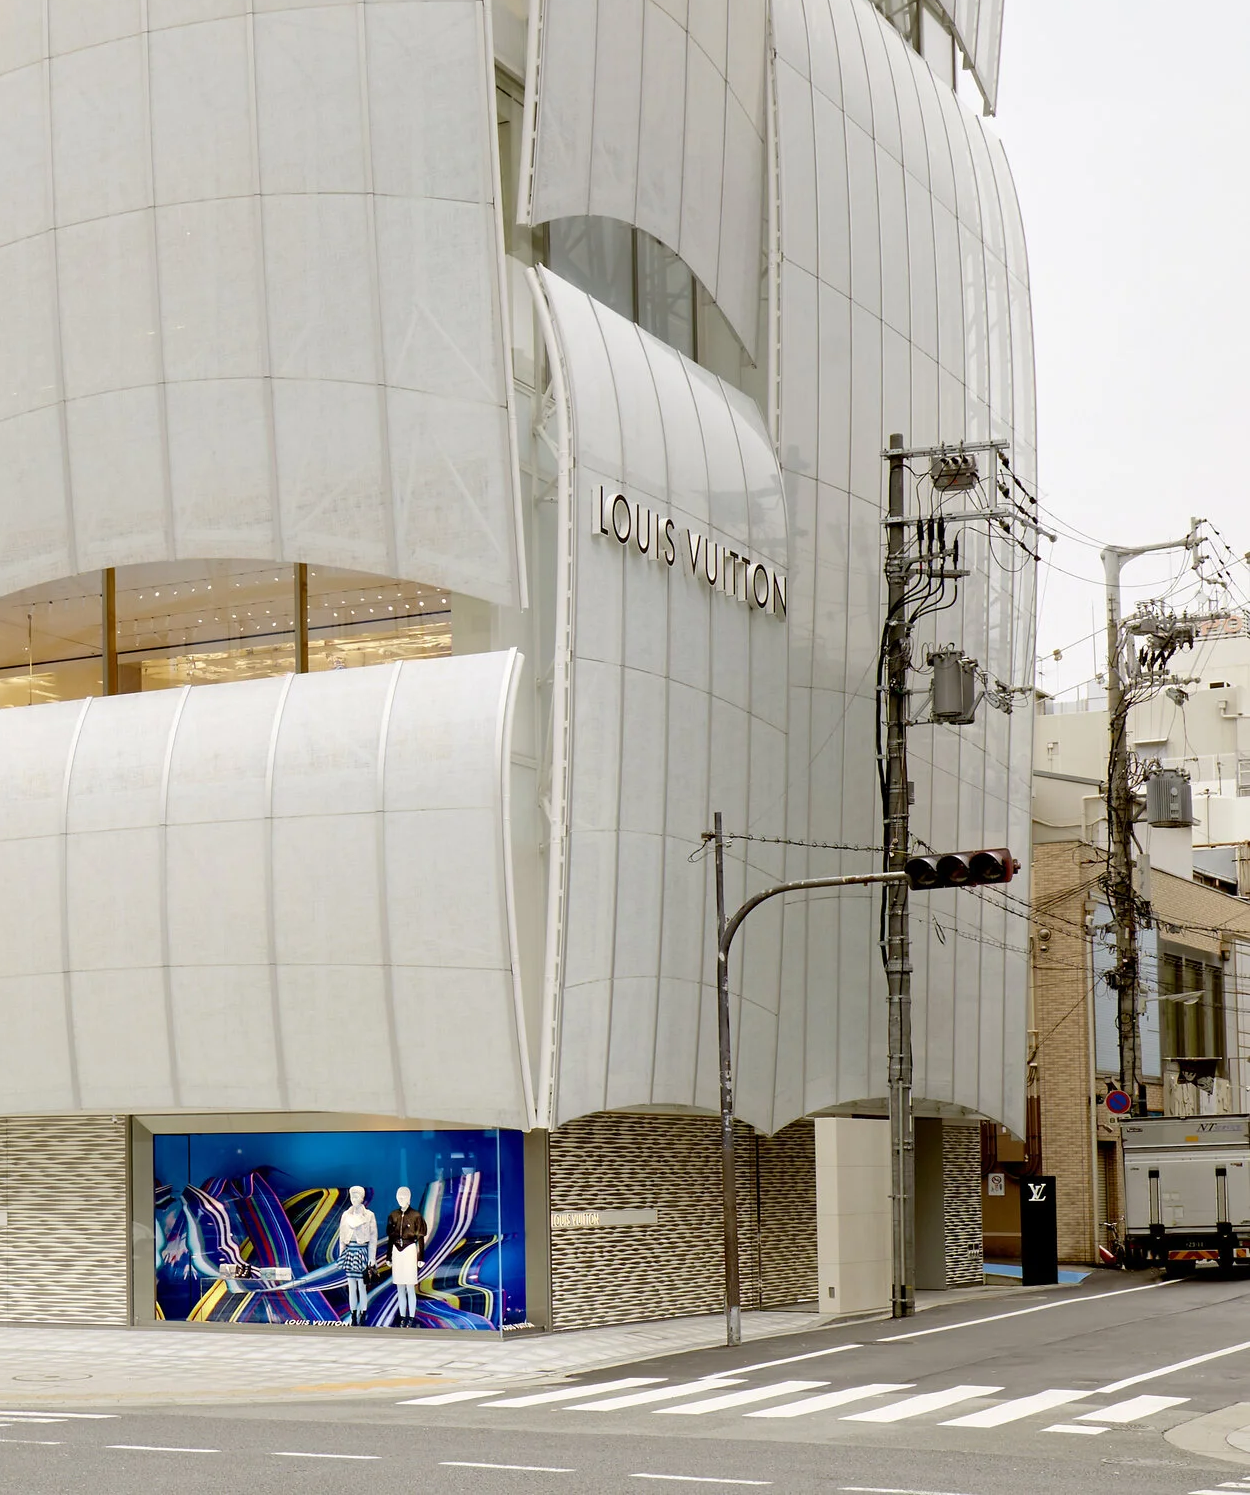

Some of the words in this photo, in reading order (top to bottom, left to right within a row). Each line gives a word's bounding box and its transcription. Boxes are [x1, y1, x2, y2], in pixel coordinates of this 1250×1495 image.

[598, 485, 675, 567] LOUIS
[684, 528, 787, 618] VUITTON
[551, 1214, 571, 1227] LOUIS
[572, 1213, 599, 1226] VUITTON
